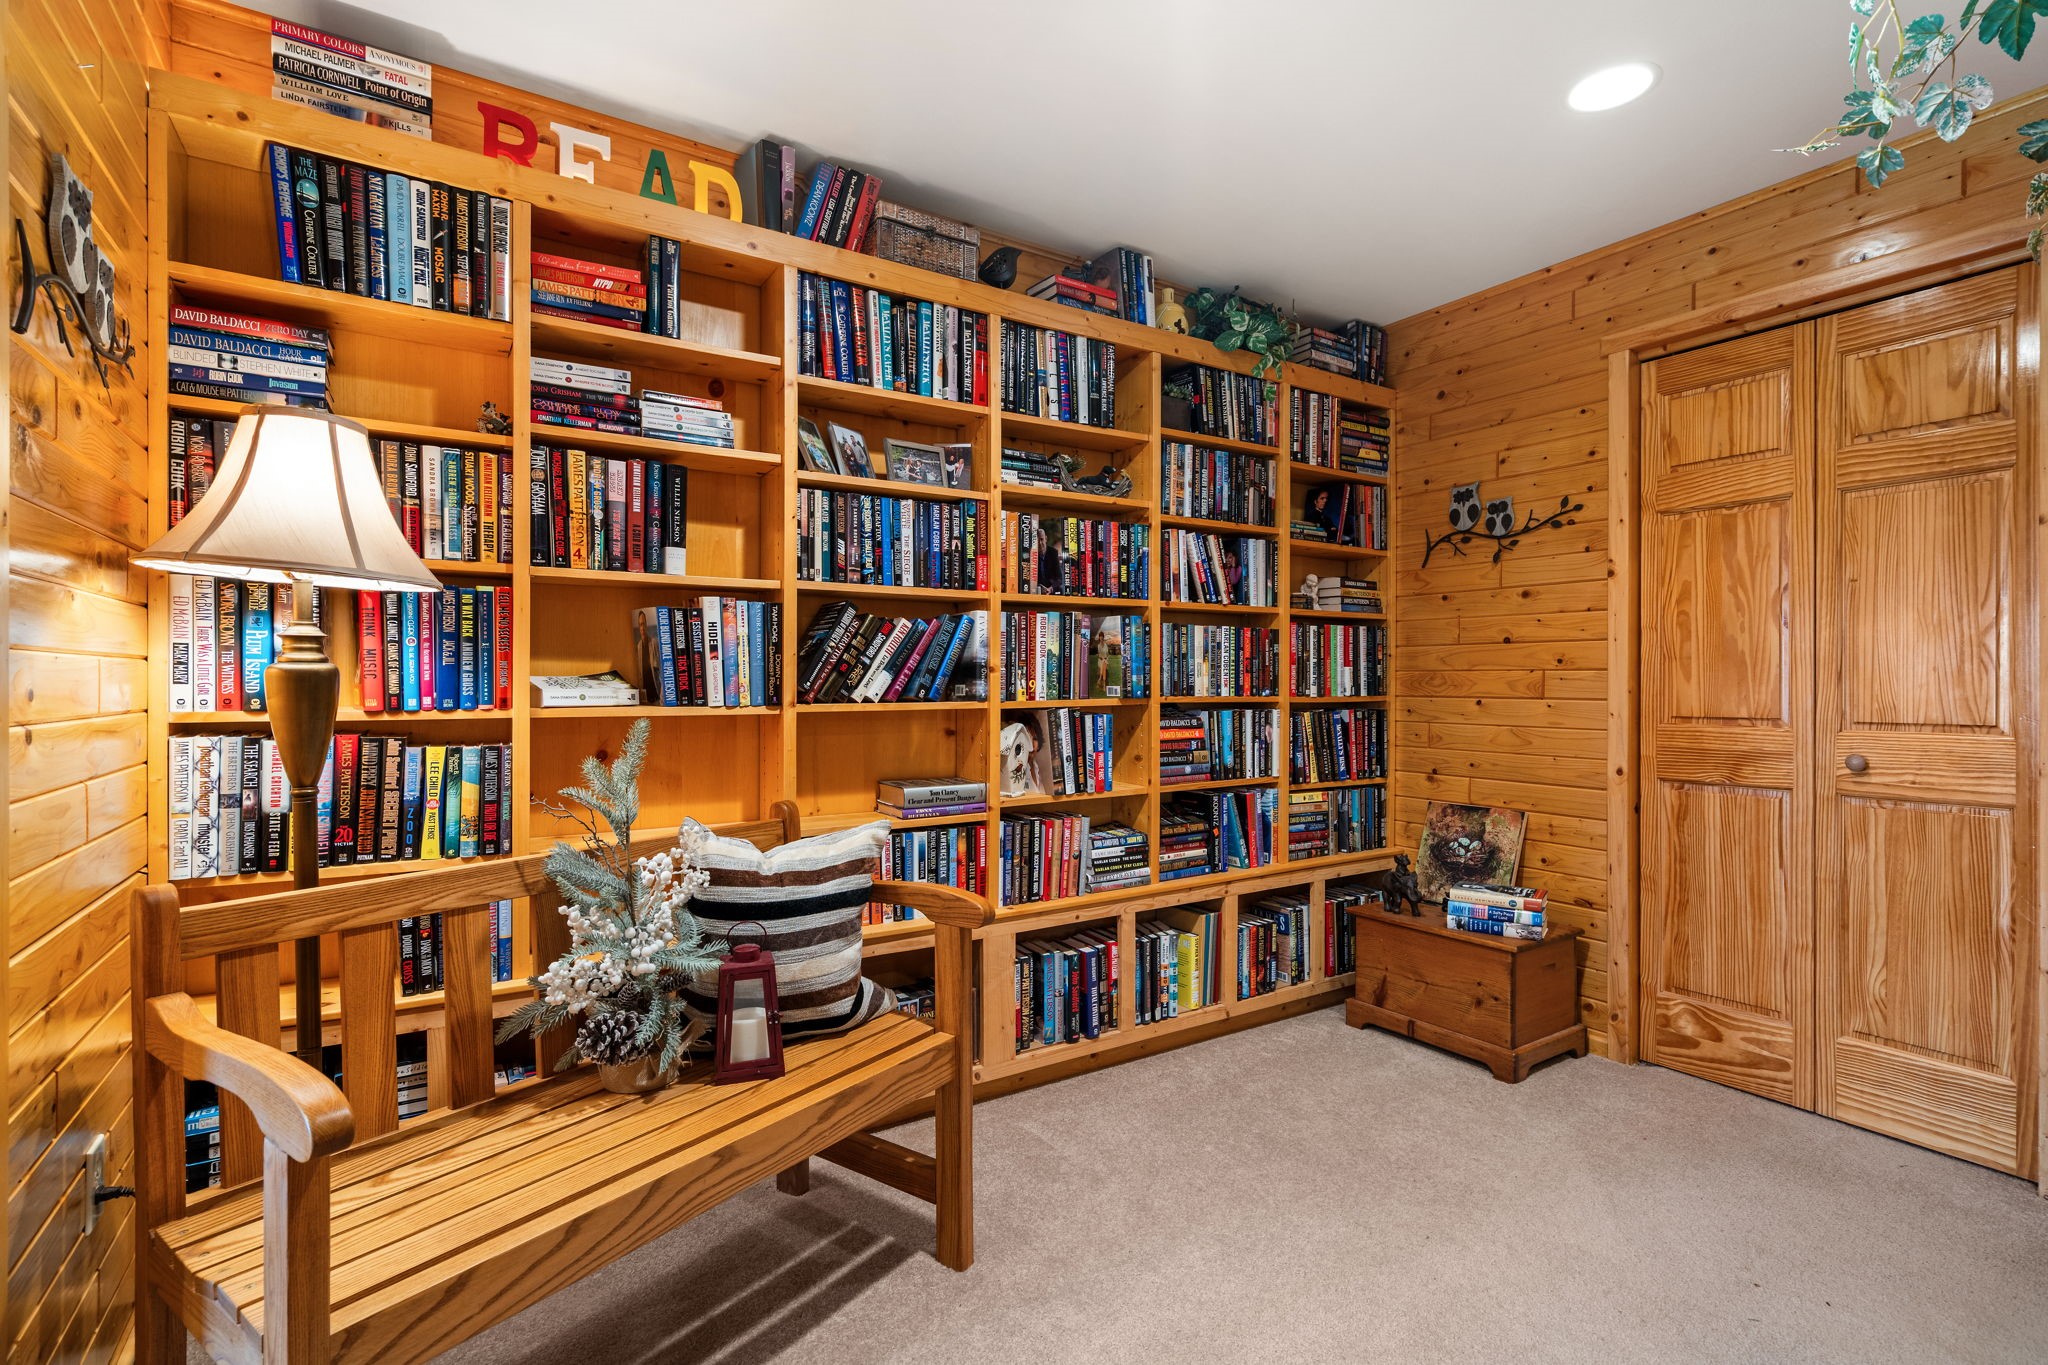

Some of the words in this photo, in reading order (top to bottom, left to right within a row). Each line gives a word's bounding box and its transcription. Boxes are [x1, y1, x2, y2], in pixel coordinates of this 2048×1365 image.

[274, 20, 321, 43] PRIMARY
[323, 33, 366, 57] COLORS
[284, 42, 322, 62] MICHAEL
[323, 52, 357, 71] PALMER
[369, 49, 416, 71] ANONYMOUS
[278, 56, 315, 76] PATRICIA
[316, 64, 361, 91] CORNWELL
[384, 71, 409, 87] FATAL
[280, 77, 322, 96] WILLIAM
[325, 89, 350, 103] LOVE
[280, 90, 306, 105] LINDA
[365, 80, 389, 99] Point
[389, 87, 400, 100] of
[400, 89, 428, 108] Origin
[274, 144, 291, 181] BISHOP'S
[295, 165, 319, 181] MAZE
[299, 156, 314, 170] THE
[477, 100, 743, 224] READ
[837, 168, 847, 181] LADY
[280, 180, 293, 219] REVENGE
[416, 188, 427, 206] JOHN
[440, 190, 450, 211] JOHN
[812, 180, 826, 200] DEAN
[831, 180, 843, 199] KILLER
[370, 192, 386, 231] GRAFTON
[432, 189, 441, 218] MAXIM
[456, 192, 470, 215] JAMES
[804, 197, 819, 227] KOONTZ
[826, 197, 837, 210] LISA
[303, 209, 316, 245] CATHERINE
[456, 213, 470, 252] PATTERSON
[304, 245, 318, 276] COULTER
[434, 246, 445, 284] MOSAIC
[537, 281, 577, 295] JAMES
[174, 308, 208, 323] DAVID
[209, 315, 259, 334] BALDACCI
[291, 327, 309, 340] DAY
[837, 314, 848, 346] CATHERINE
[172, 350, 218, 366] BLINDED
[174, 332, 212, 348] DAVID
[212, 337, 272, 358] BALDACCI
[239, 359, 284, 374] STEPHEN
[840, 346, 851, 376] COULTER
[1020, 354, 1028, 383] COOK
[268, 377, 299, 391] Invasion
[170, 420, 185, 456] ROBIN
[190, 435, 206, 454] NORA
[386, 444, 399, 472] SANDRA
[404, 445, 418, 463] JOHN
[464, 451, 475, 479] STUART
[530, 449, 546, 469] JOHN
[170, 458, 185, 491] COOK
[404, 462, 419, 498] SANDFORD
[429, 457, 439, 486] SANDRA
[448, 460, 458, 486] ANDREW
[483, 455, 494, 485] JONATHAN
[571, 453, 584, 486] JAMES
[386, 472, 400, 499] BROWN
[448, 487, 458, 508] GROSS
[464, 477, 476, 506] WOODS
[501, 472, 513, 506] SANDFORD
[531, 481, 546, 516] GRISHAM
[572, 486, 585, 547] PATTERSON
[673, 509, 681, 543] NELSON
[875, 511, 883, 541] GRAFTON
[933, 504, 941, 530] HARLAN
[966, 516, 976, 532] John
[1022, 515, 1032, 524] UP
[482, 521, 495, 554] THERAPY
[932, 530, 941, 552] COBEN
[966, 532, 976, 559] Sandford
[1022, 523, 1032, 549] COUNTRY
[903, 549, 912, 576] SIEGE
[195, 579, 213, 590] ED
[220, 582, 237, 613] SANDRA
[172, 595, 190, 607] ED
[194, 591, 213, 622] McBAIN
[386, 593, 399, 616] WILLIAM
[461, 593, 474, 603] NO
[172, 608, 191, 640] McBAIN
[363, 606, 377, 638] TRUNK
[461, 604, 474, 620] WAY
[658, 608, 671, 625] FOUR
[219, 614, 237, 647] BROWN
[461, 619, 474, 638] BACK
[660, 625, 672, 644] BLIND
[707, 621, 718, 645] HIDE
[771, 622, 779, 643] HOAG
[958, 619, 974, 641] JOHN
[1039, 615, 1048, 639] ROBIN
[245, 629, 269, 656] PLUM
[442, 639, 456, 652] JACK
[829, 631, 852, 665] GRAFTON
[865, 631, 888, 659] SANDFORD
[1039, 639, 1048, 659] COOK
[221, 650, 235, 664] THE
[363, 647, 378, 681] MUSIC
[461, 641, 474, 671] ANDREW
[677, 654, 689, 671] TICK
[943, 638, 967, 675] SANDFORD
[1029, 637, 1037, 679] PATTERSON
[173, 663, 190, 685] MARY
[221, 662, 235, 695] WITNESS
[244, 657, 268, 694] ISLAND
[461, 671, 474, 697] GROSS
[679, 671, 689, 691] TOCK
[173, 739, 189, 763] JAMES
[227, 740, 239, 755] THE
[244, 743, 259, 759] THE
[341, 739, 353, 768] JAMES
[362, 741, 379, 766] MIND
[484, 748, 499, 768] JAMES
[196, 745, 215, 780] jonathan
[227, 754, 238, 791] BRETHREN
[243, 759, 259, 788] SEARCH
[430, 761, 441, 776] LEE
[173, 761, 189, 804] PATTERSON
[360, 765, 378, 787] PREY
[428, 775, 440, 798] CHILD
[484, 768, 499, 802] PATTERSON
[198, 779, 215, 819] kellerman
[270, 775, 283, 809] CRICHTON
[339, 768, 352, 820] PATTERSON
[359, 787, 377, 810] JOHN
[928, 789, 942, 798] Tom
[942, 788, 960, 797] Clancy
[226, 810, 237, 830] JOHN
[382, 790, 400, 829] SECRET
[427, 811, 438, 826] PAST
[1211, 795, 1220, 828] KOONTZ
[173, 818, 190, 846] CRADLE
[268, 811, 283, 836] STATE
[196, 822, 212, 856] monster
[268, 841, 281, 858] FEAR
[381, 828, 399, 856] PREY
[939, 830, 949, 861] LAWRENCE
[174, 857, 189, 871] ALL
[402, 934, 413, 959] DOUBLE
[402, 959, 414, 985] CROSS
[1022, 978, 1031, 1016] PATTERSON
